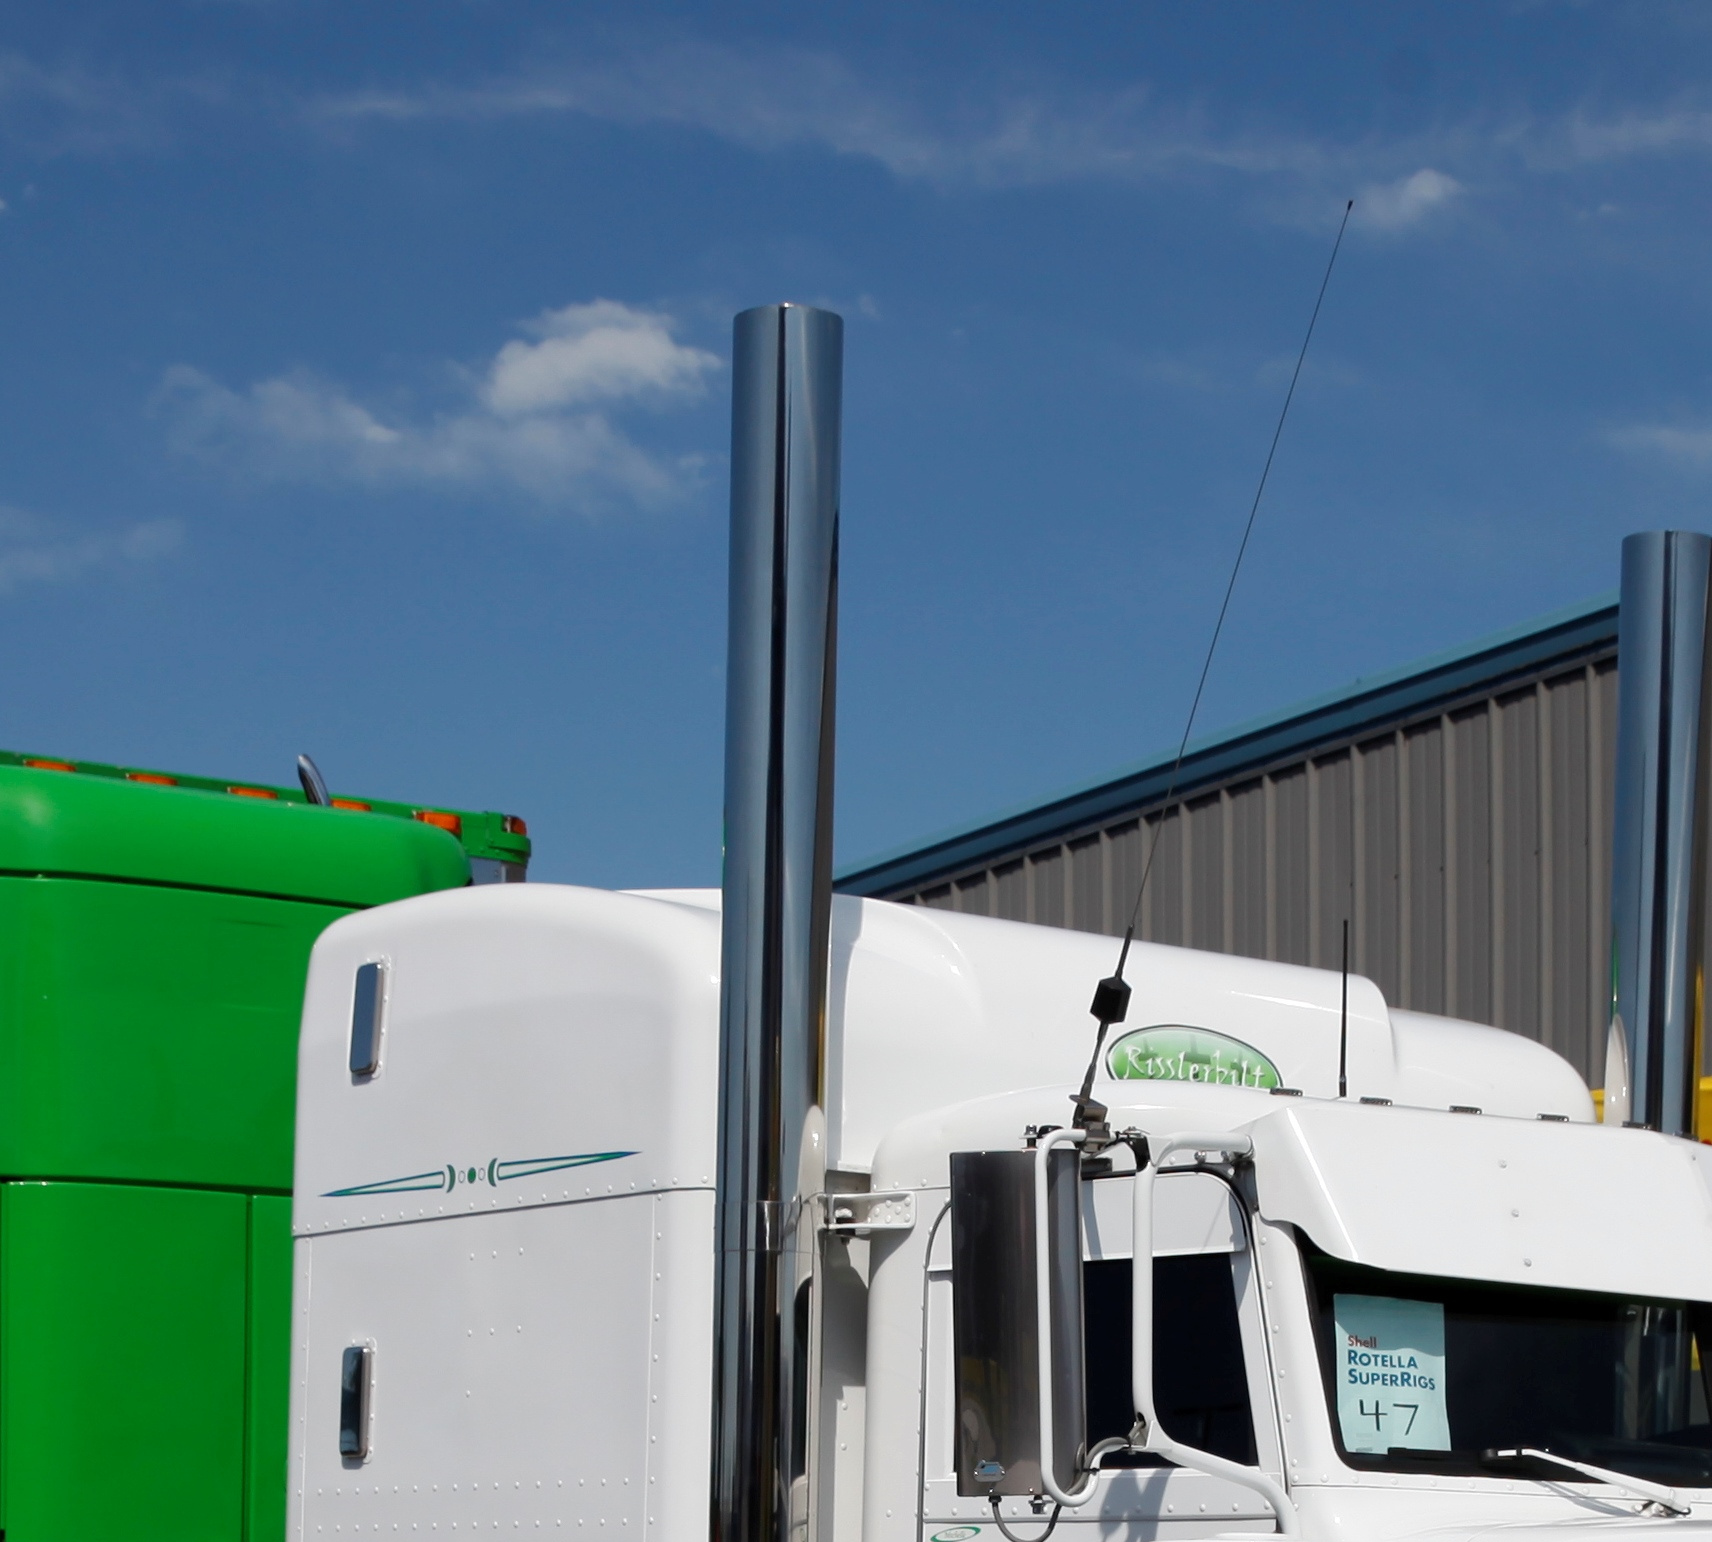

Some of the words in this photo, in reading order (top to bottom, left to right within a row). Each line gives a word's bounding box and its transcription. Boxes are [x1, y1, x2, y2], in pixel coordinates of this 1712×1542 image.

[1347, 1334, 1378, 1349] Shell
[1347, 1349, 1419, 1370] ROTELLA
[1358, 1398, 1420, 1436] 47
